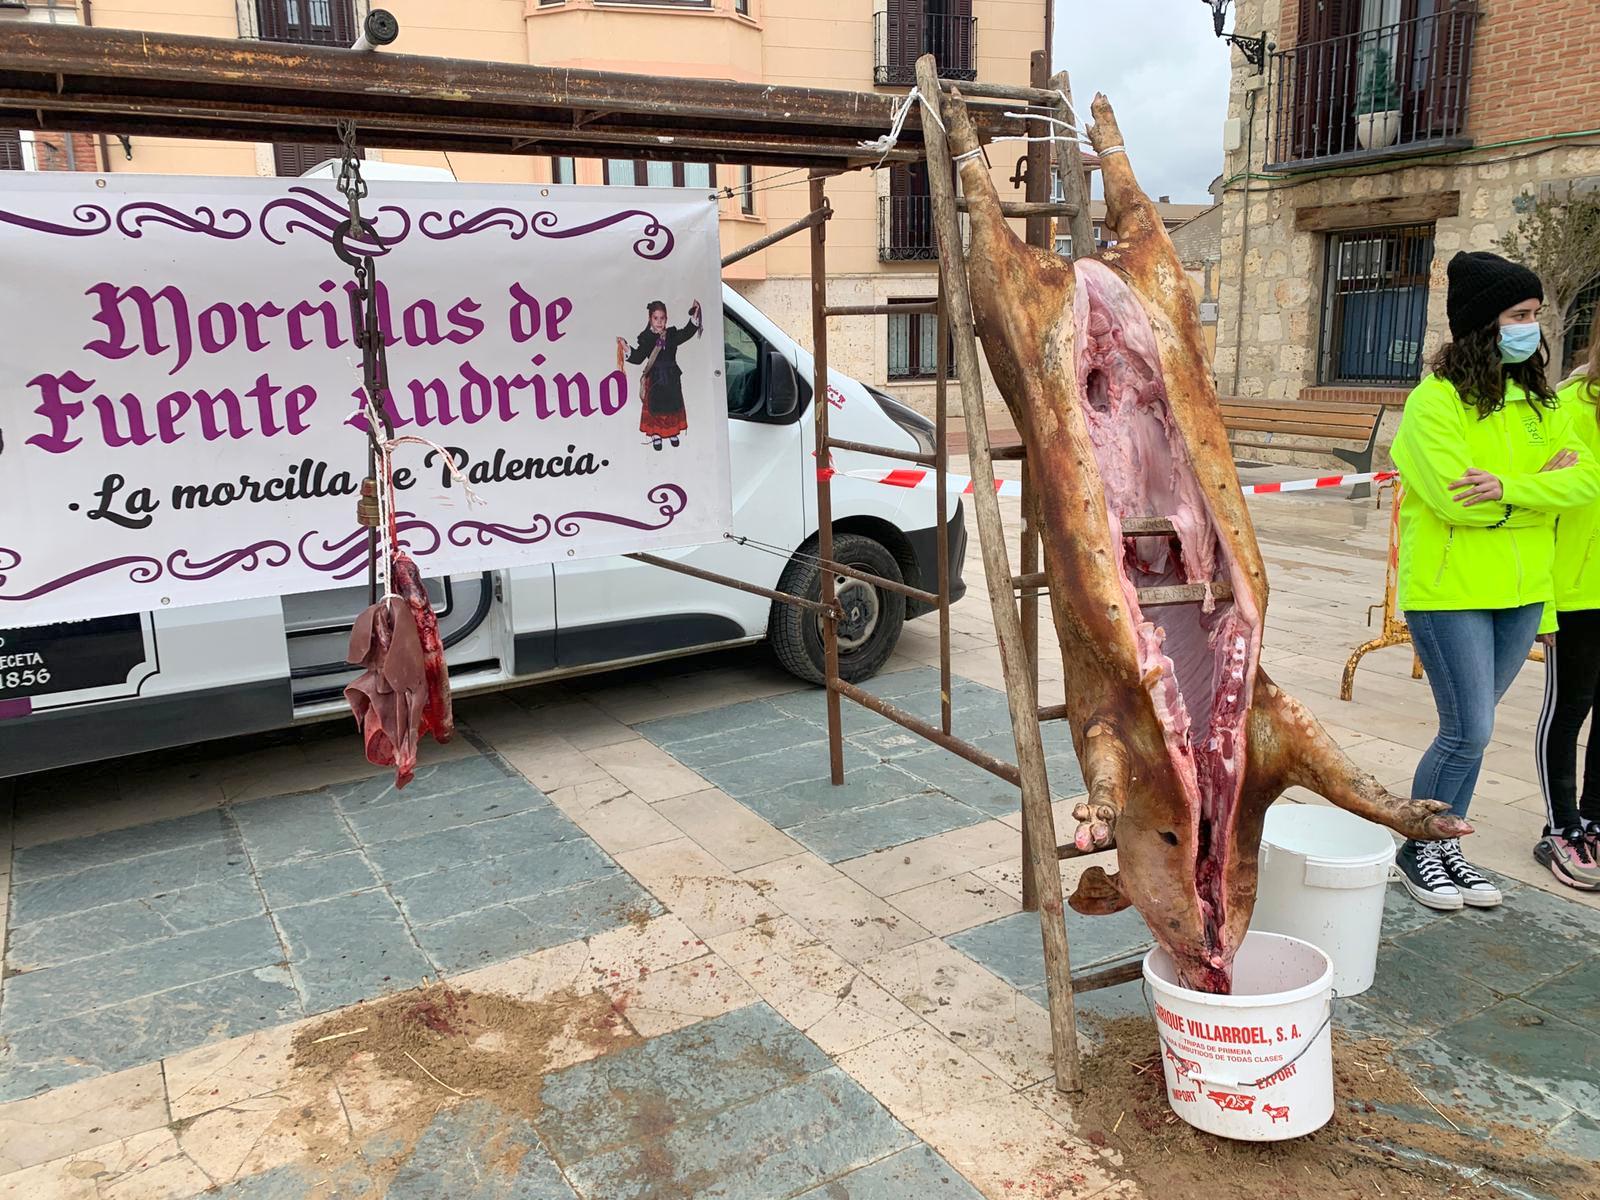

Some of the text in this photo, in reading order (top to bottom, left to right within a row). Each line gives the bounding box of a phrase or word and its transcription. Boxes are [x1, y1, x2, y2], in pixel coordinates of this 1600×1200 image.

[82, 280, 573, 376] Morcillas de
[25, 370, 317, 454] Fuente
[171, 458, 358, 511] morcilla
[1187, 1019, 1272, 1046] VILLARROEL,
[1276, 1026, 1287, 1042] S.
[1291, 1024, 1302, 1039] A.
[1178, 1042, 1214, 1059] EMBUTIDOS
[1227, 1055, 1252, 1063] TODAS
[1254, 1055, 1283, 1063] CLASES
[1184, 1038, 1205, 1051] TRIPAS
[1218, 1047, 1252, 1055] PRIMERA
[1256, 1063, 1298, 1090] EXPORT
